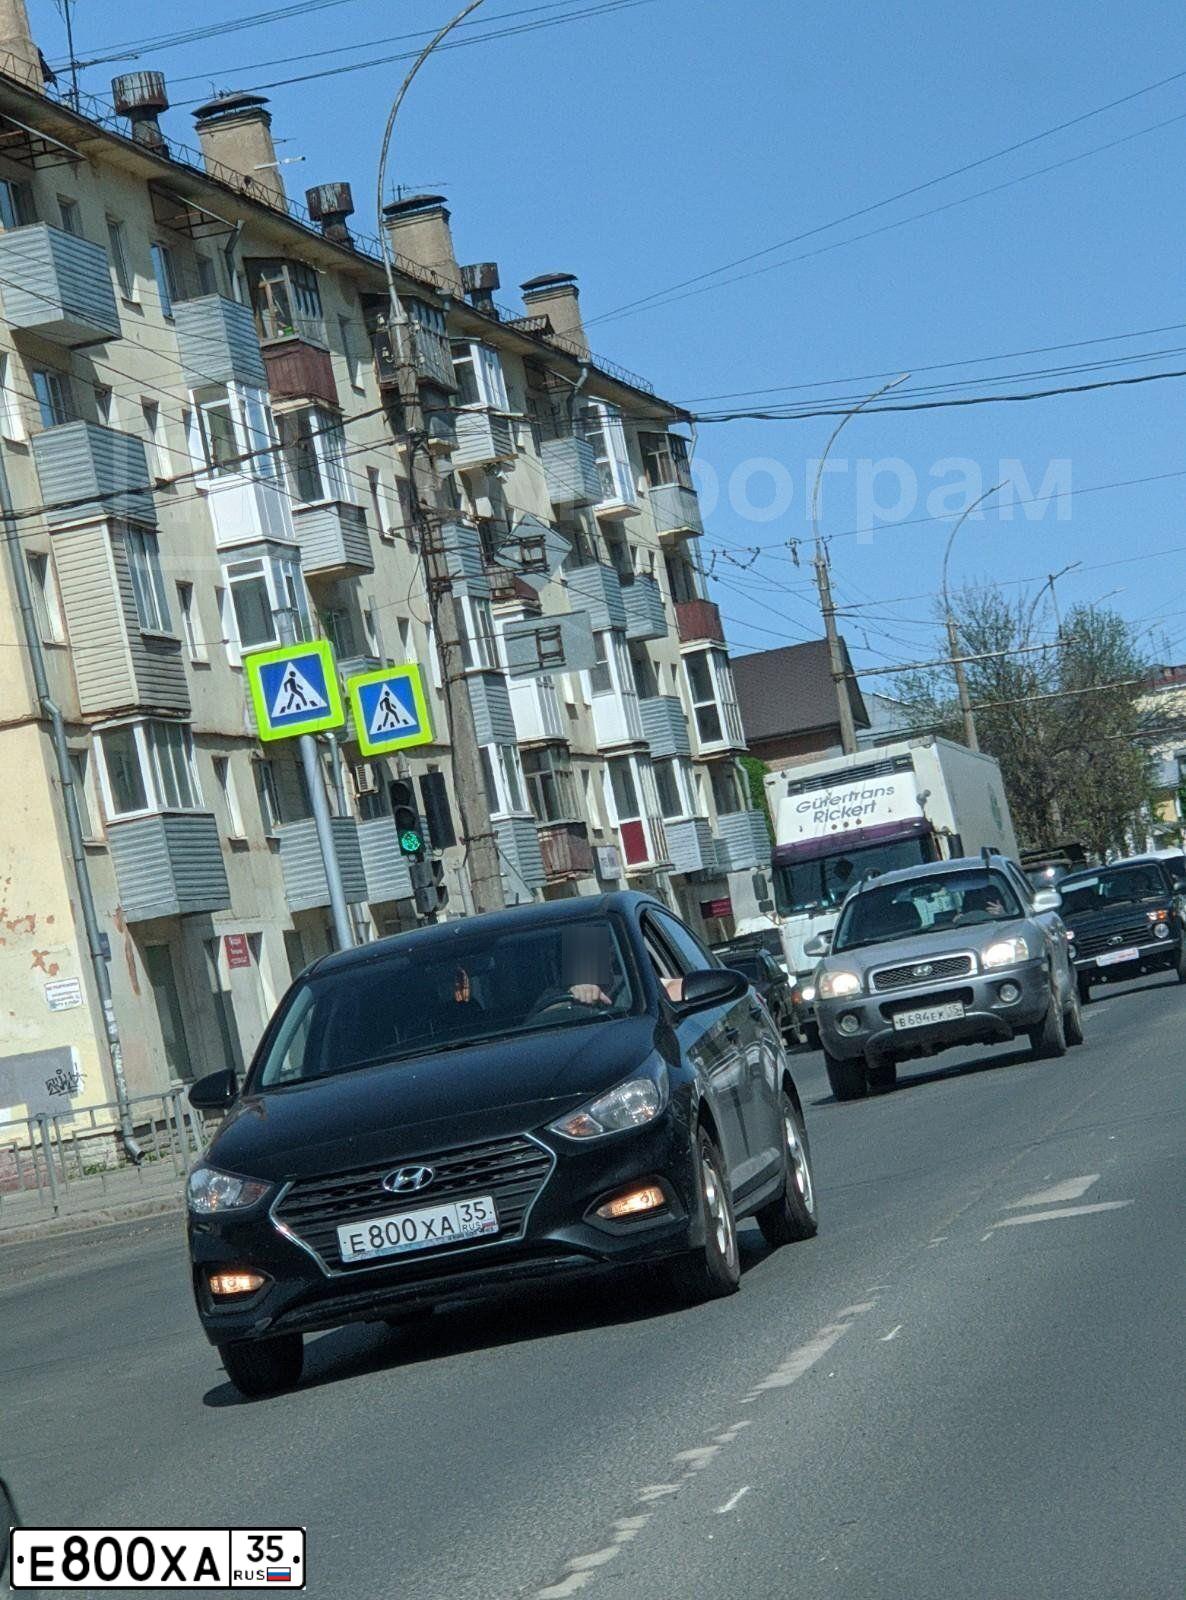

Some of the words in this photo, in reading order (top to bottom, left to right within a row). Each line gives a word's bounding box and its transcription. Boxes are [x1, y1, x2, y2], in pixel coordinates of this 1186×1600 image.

[813, 799, 877, 823] Rickert
[349, 1216, 455, 1254] Е800ХА
[460, 1201, 487, 1223] 35
[462, 1221, 482, 1232] RUS
